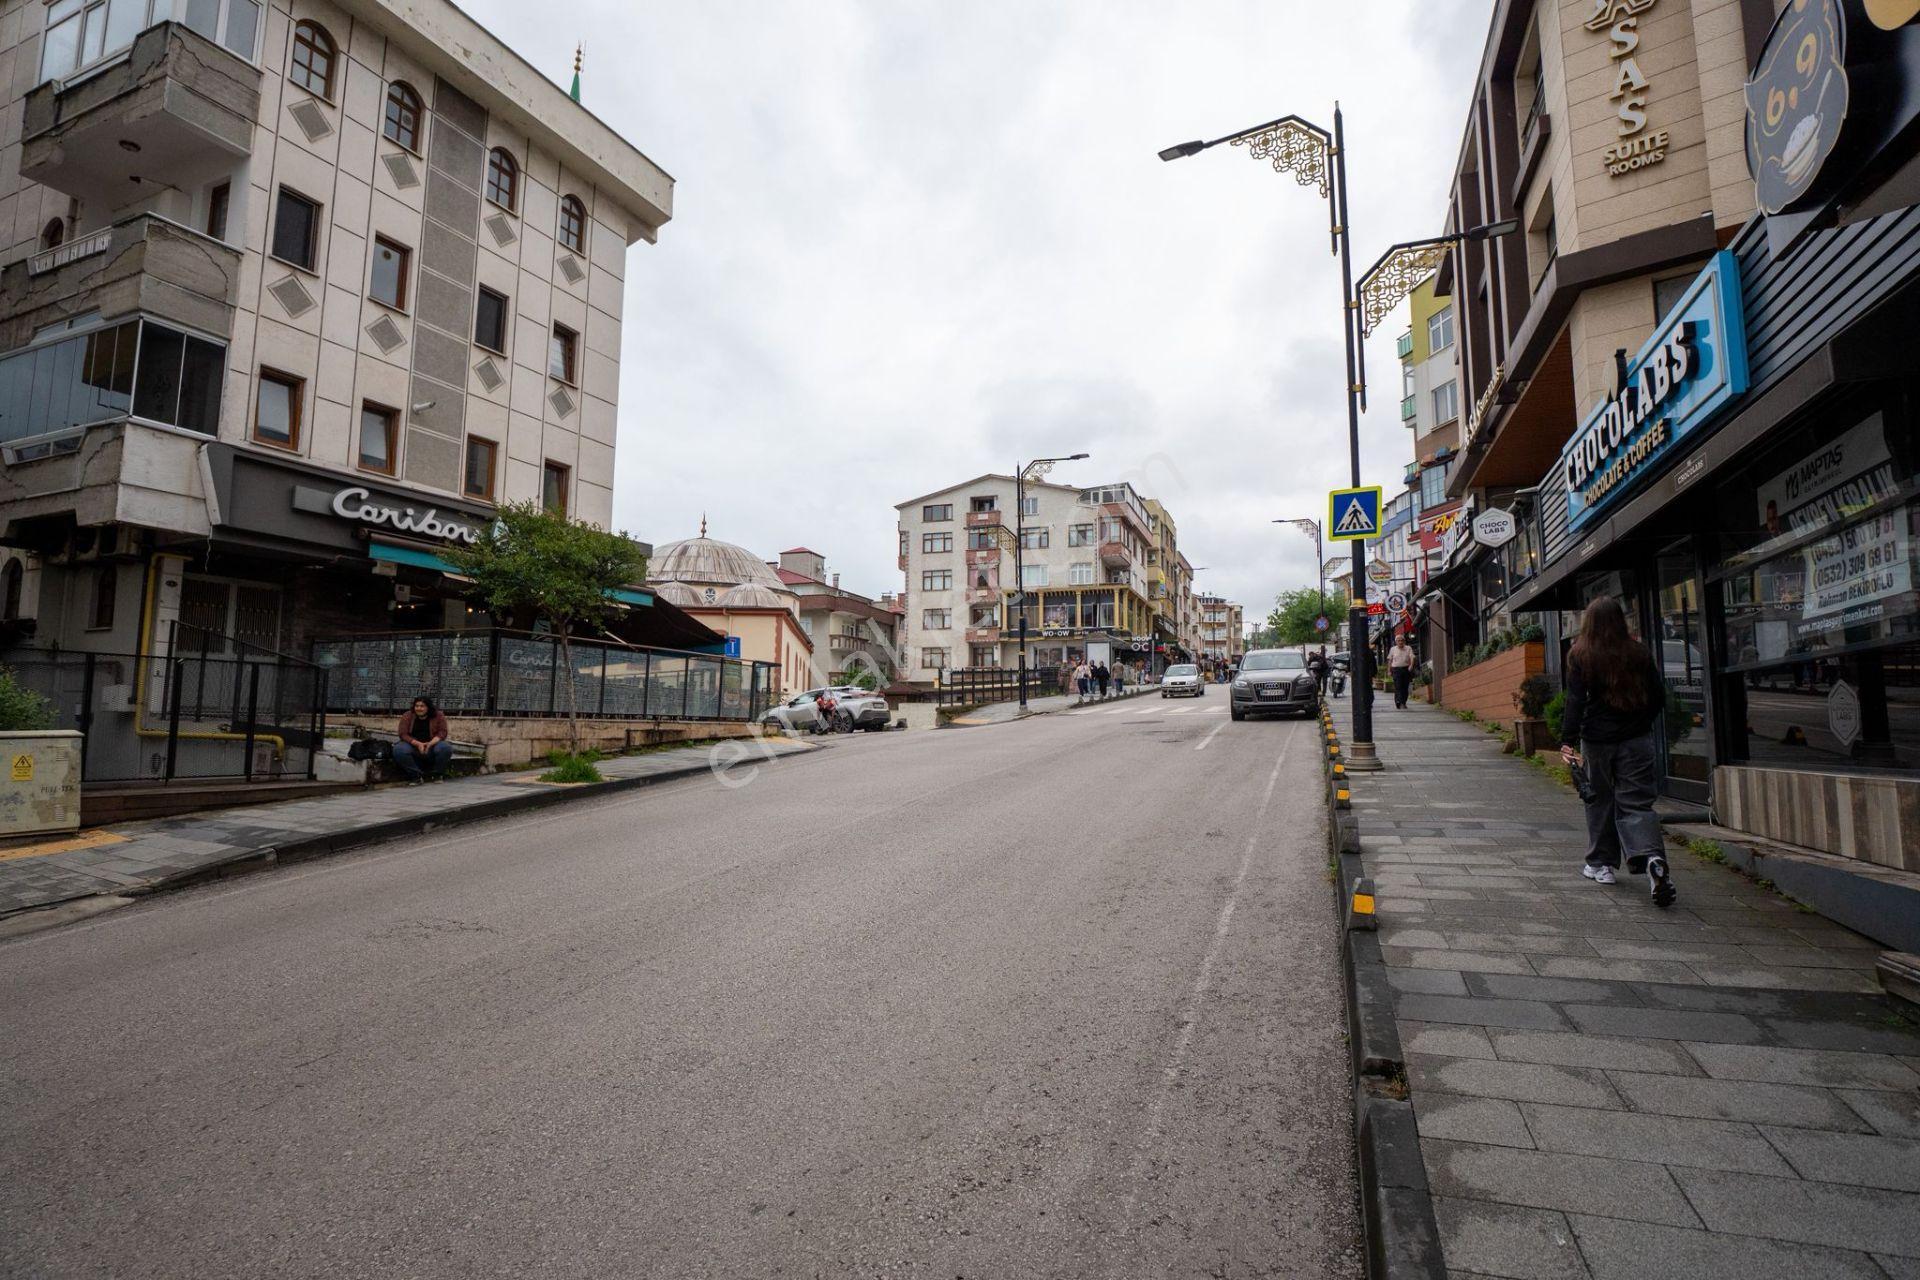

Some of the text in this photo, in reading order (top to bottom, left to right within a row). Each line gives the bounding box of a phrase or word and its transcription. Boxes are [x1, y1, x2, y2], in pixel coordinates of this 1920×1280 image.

[1603, 131, 1669, 166] SUITE
[1608, 148, 1666, 177] ROOMS
[1565, 321, 1693, 492] CHOCOLABS
[1584, 459, 1623, 508] CHOCOLATE
[1630, 418, 1666, 467] COFFEE
[1800, 444, 1843, 484] MAPTAŞ
[1479, 520, 1508, 530] CHOCO
[1484, 527, 1506, 535] LABS
[1812, 560, 1847, 590] (0532)
[1848, 552, 1866, 576] 309
[1884, 540, 1897, 562] 61
